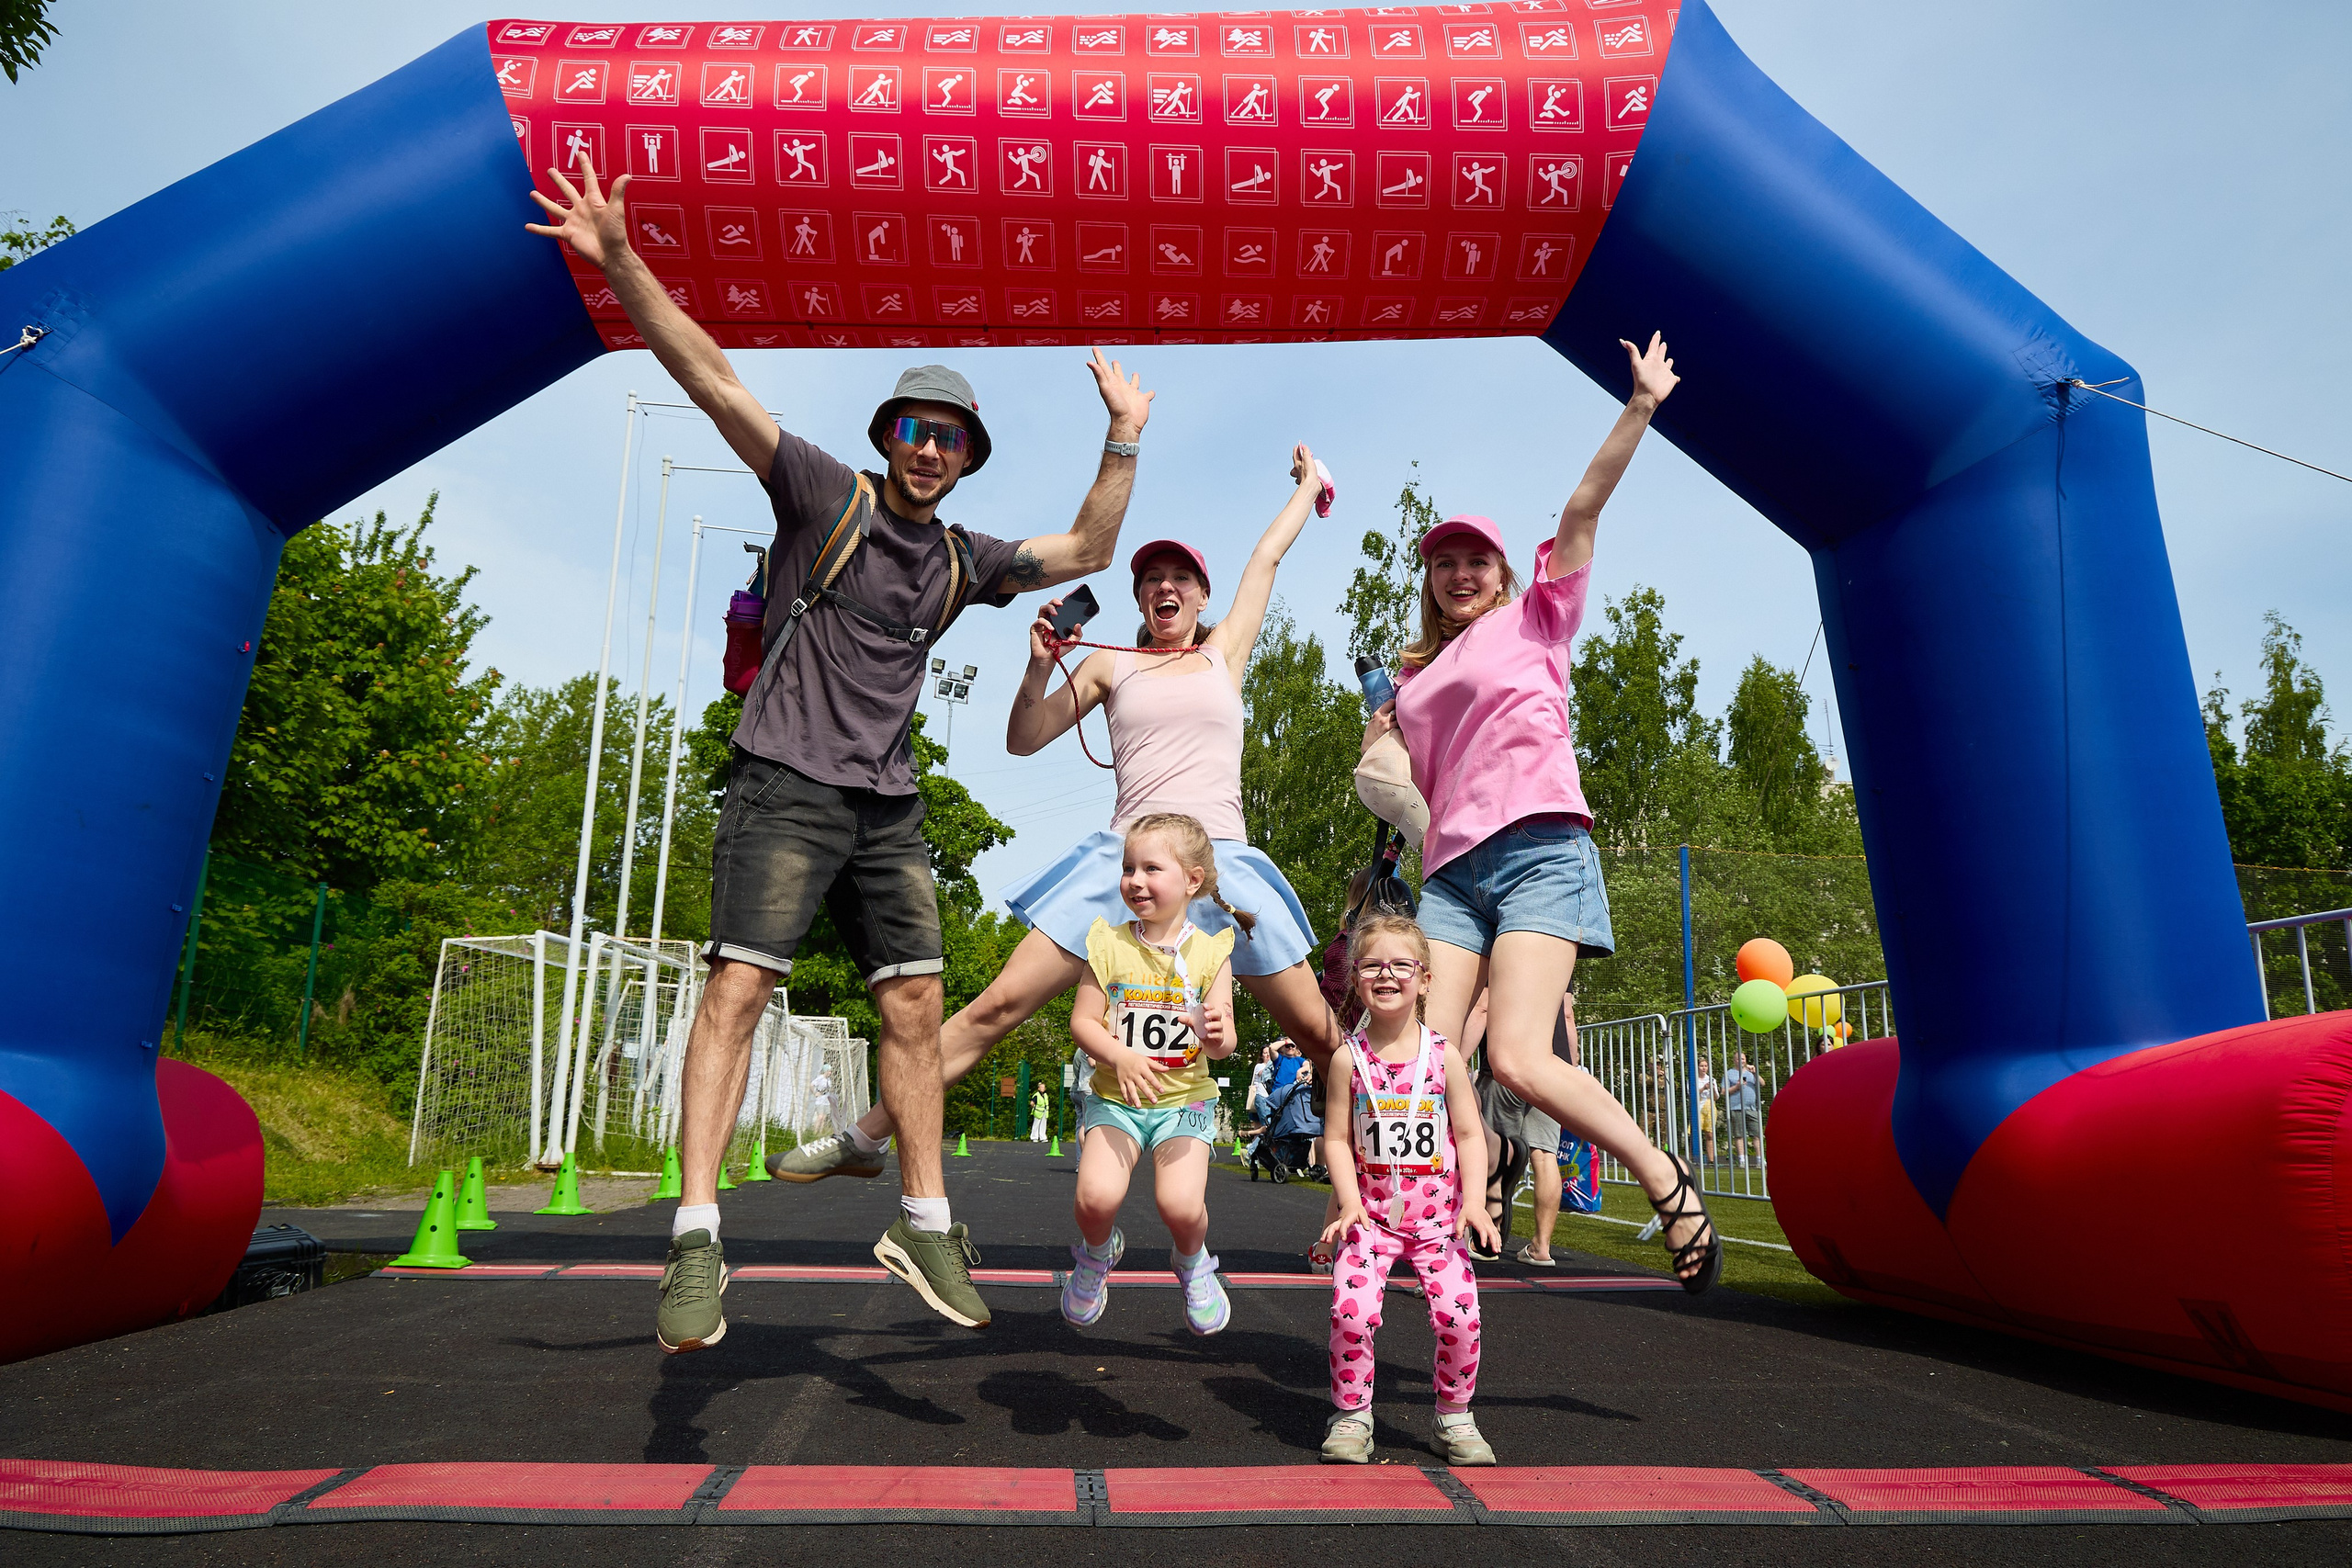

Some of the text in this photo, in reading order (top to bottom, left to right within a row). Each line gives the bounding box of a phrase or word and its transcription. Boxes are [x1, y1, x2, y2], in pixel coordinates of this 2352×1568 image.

[1124, 988, 1184, 1005] КОЛОБО
[1121, 1011, 1190, 1051] 162
[1177, 1106, 1207, 1132] YOU
[1365, 1122, 1435, 1158] 138
